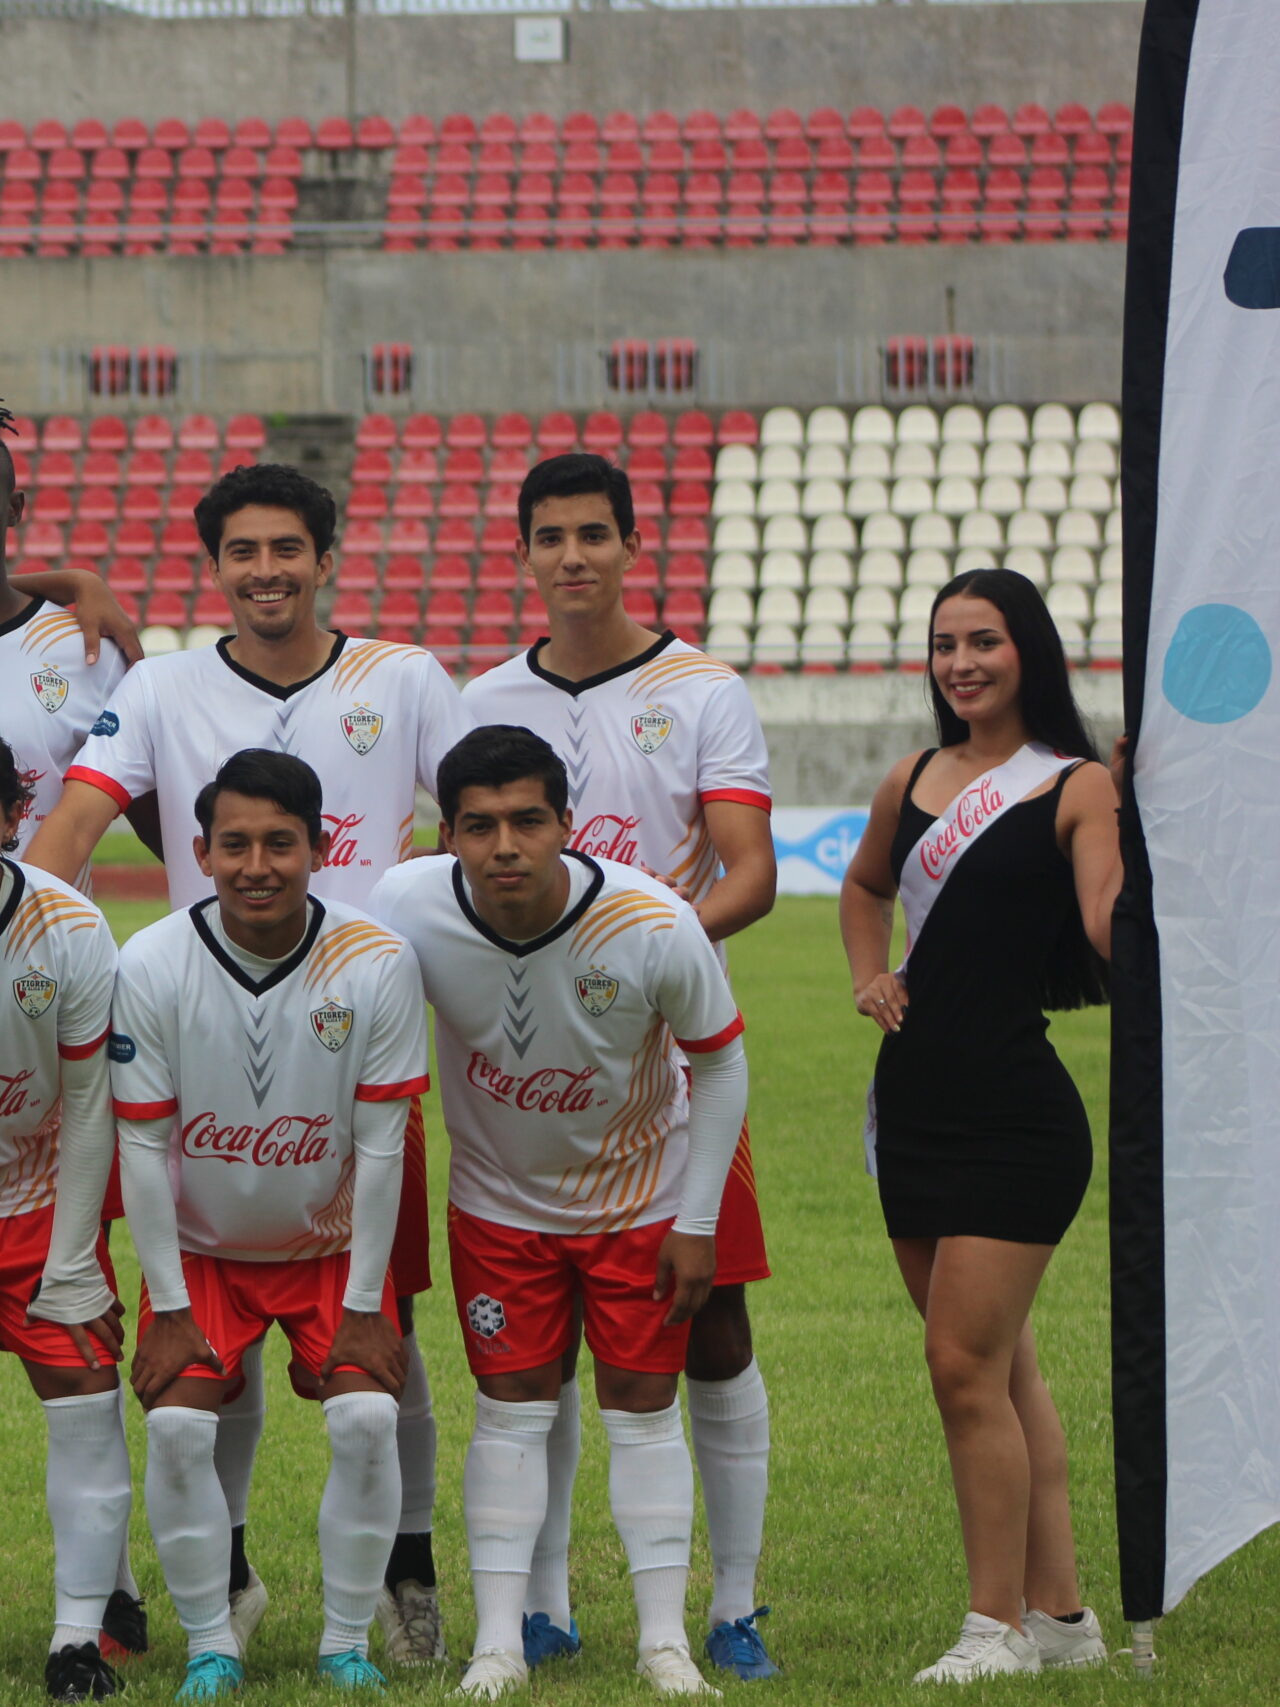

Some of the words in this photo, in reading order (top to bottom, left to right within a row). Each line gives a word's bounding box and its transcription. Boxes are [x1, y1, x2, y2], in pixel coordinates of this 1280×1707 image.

[638, 716, 666, 724] TIGRES
[920, 775, 1004, 881] Coca-Cola
[360, 859, 372, 867] MR
[582, 978, 612, 986] TIGRES
[317, 1011, 348, 1019] TIGRES
[466, 1052, 600, 1114] Coca-Cola
[179, 1112, 334, 1167] Coca-Cola
